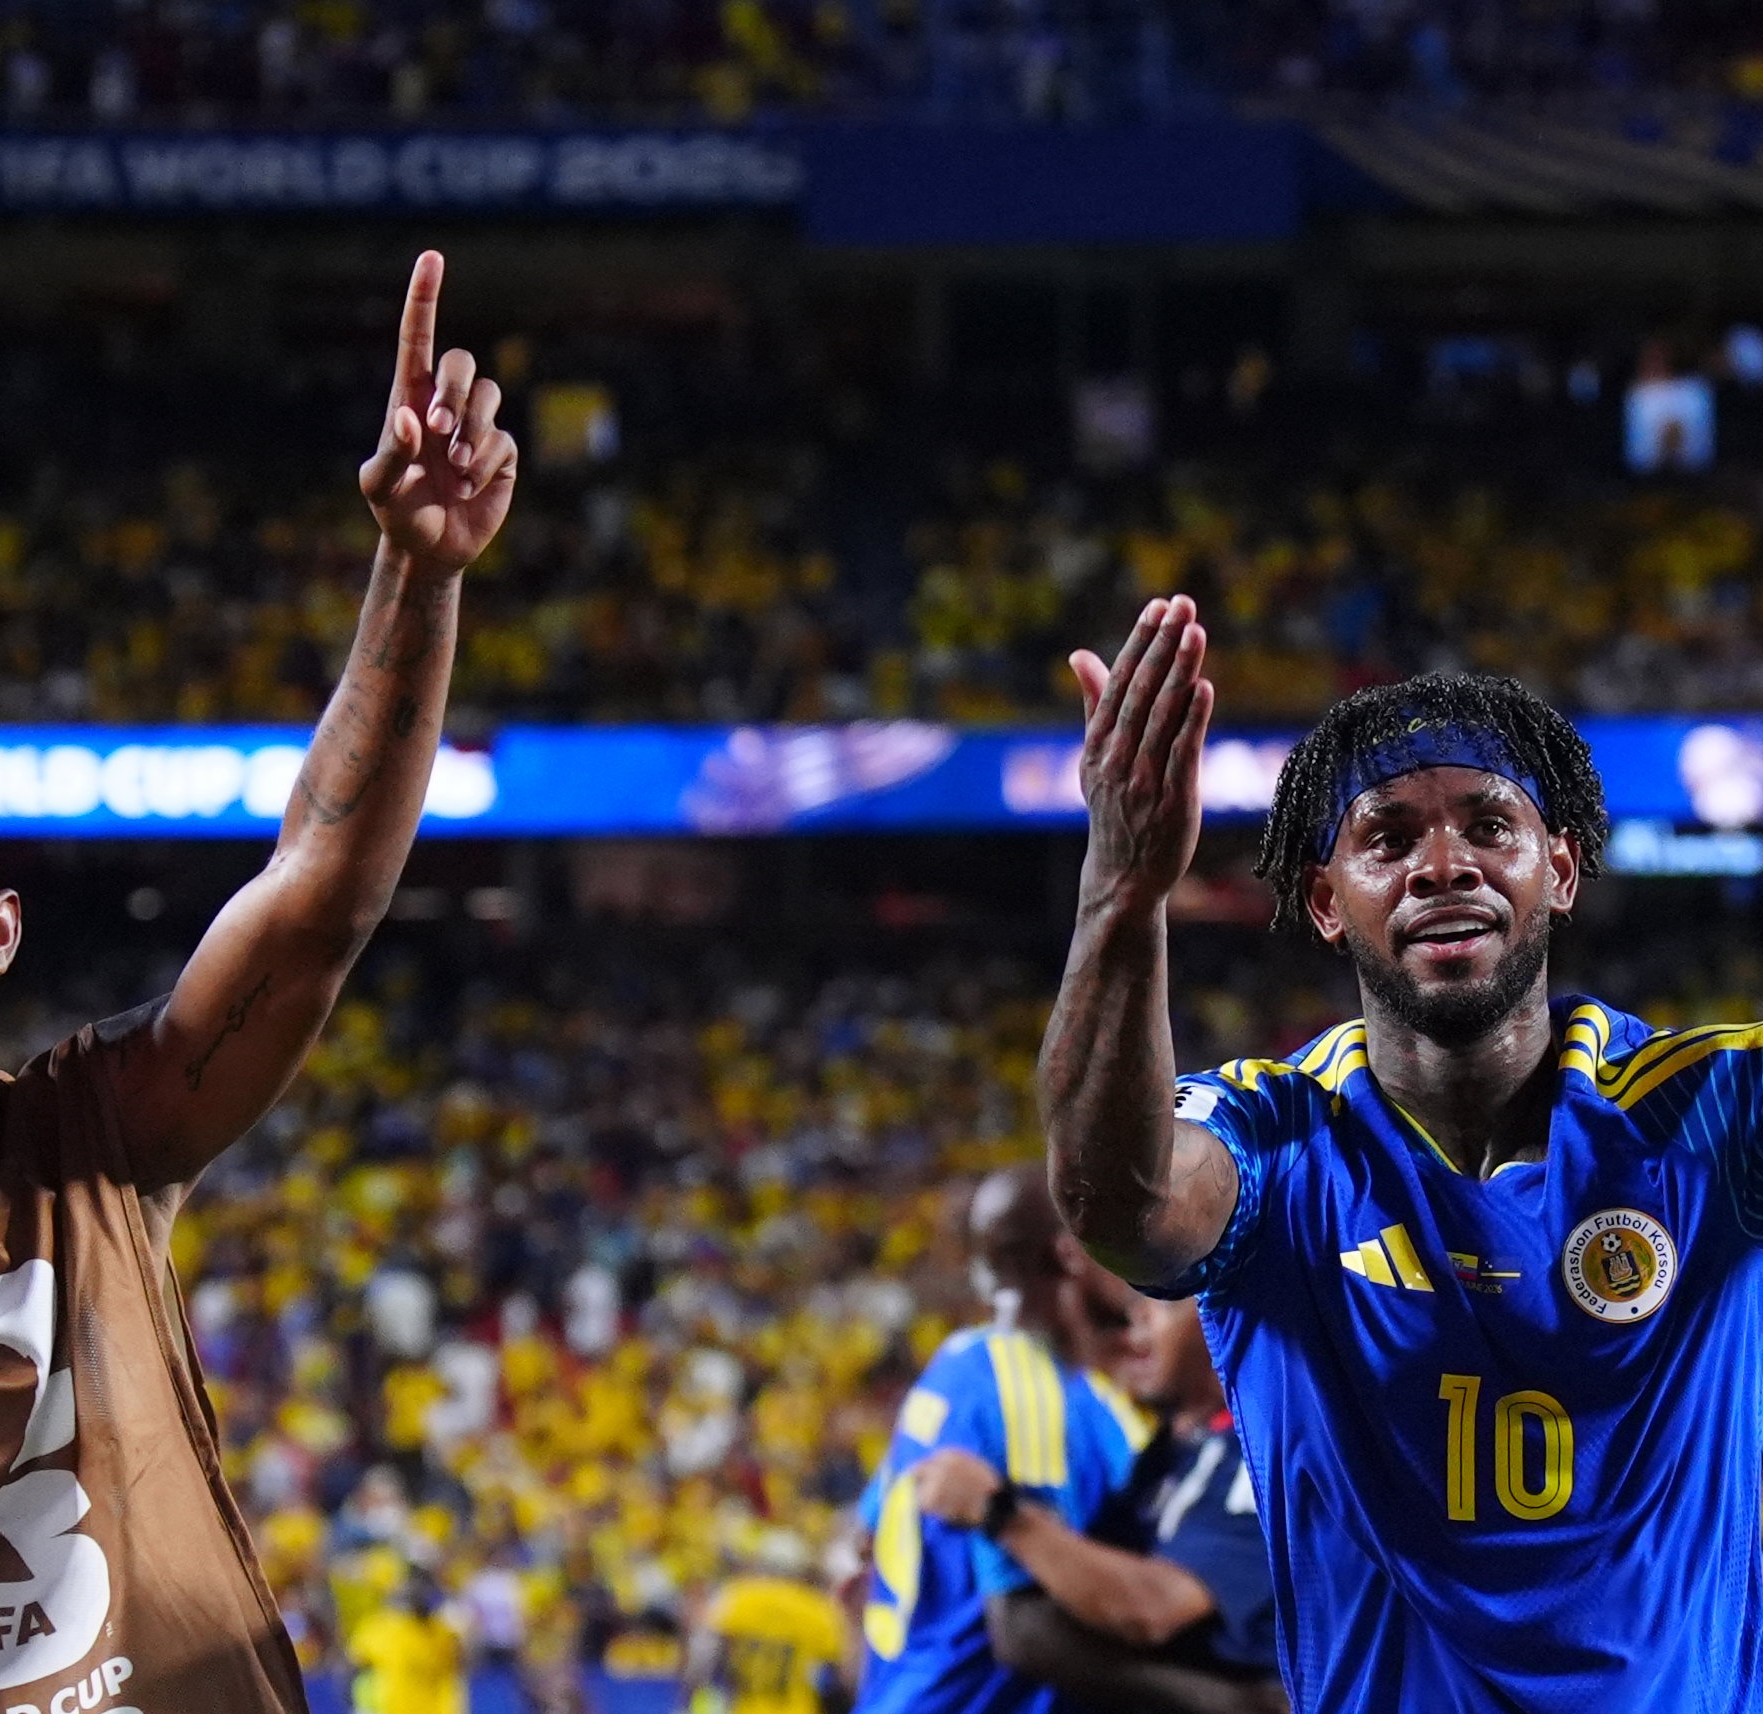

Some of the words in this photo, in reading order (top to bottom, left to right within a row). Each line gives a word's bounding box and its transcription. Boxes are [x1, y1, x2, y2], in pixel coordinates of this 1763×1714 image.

[123, 138, 385, 199] WORLD
[392, 138, 540, 199] CUP
[1438, 1374, 1574, 1521] 10
